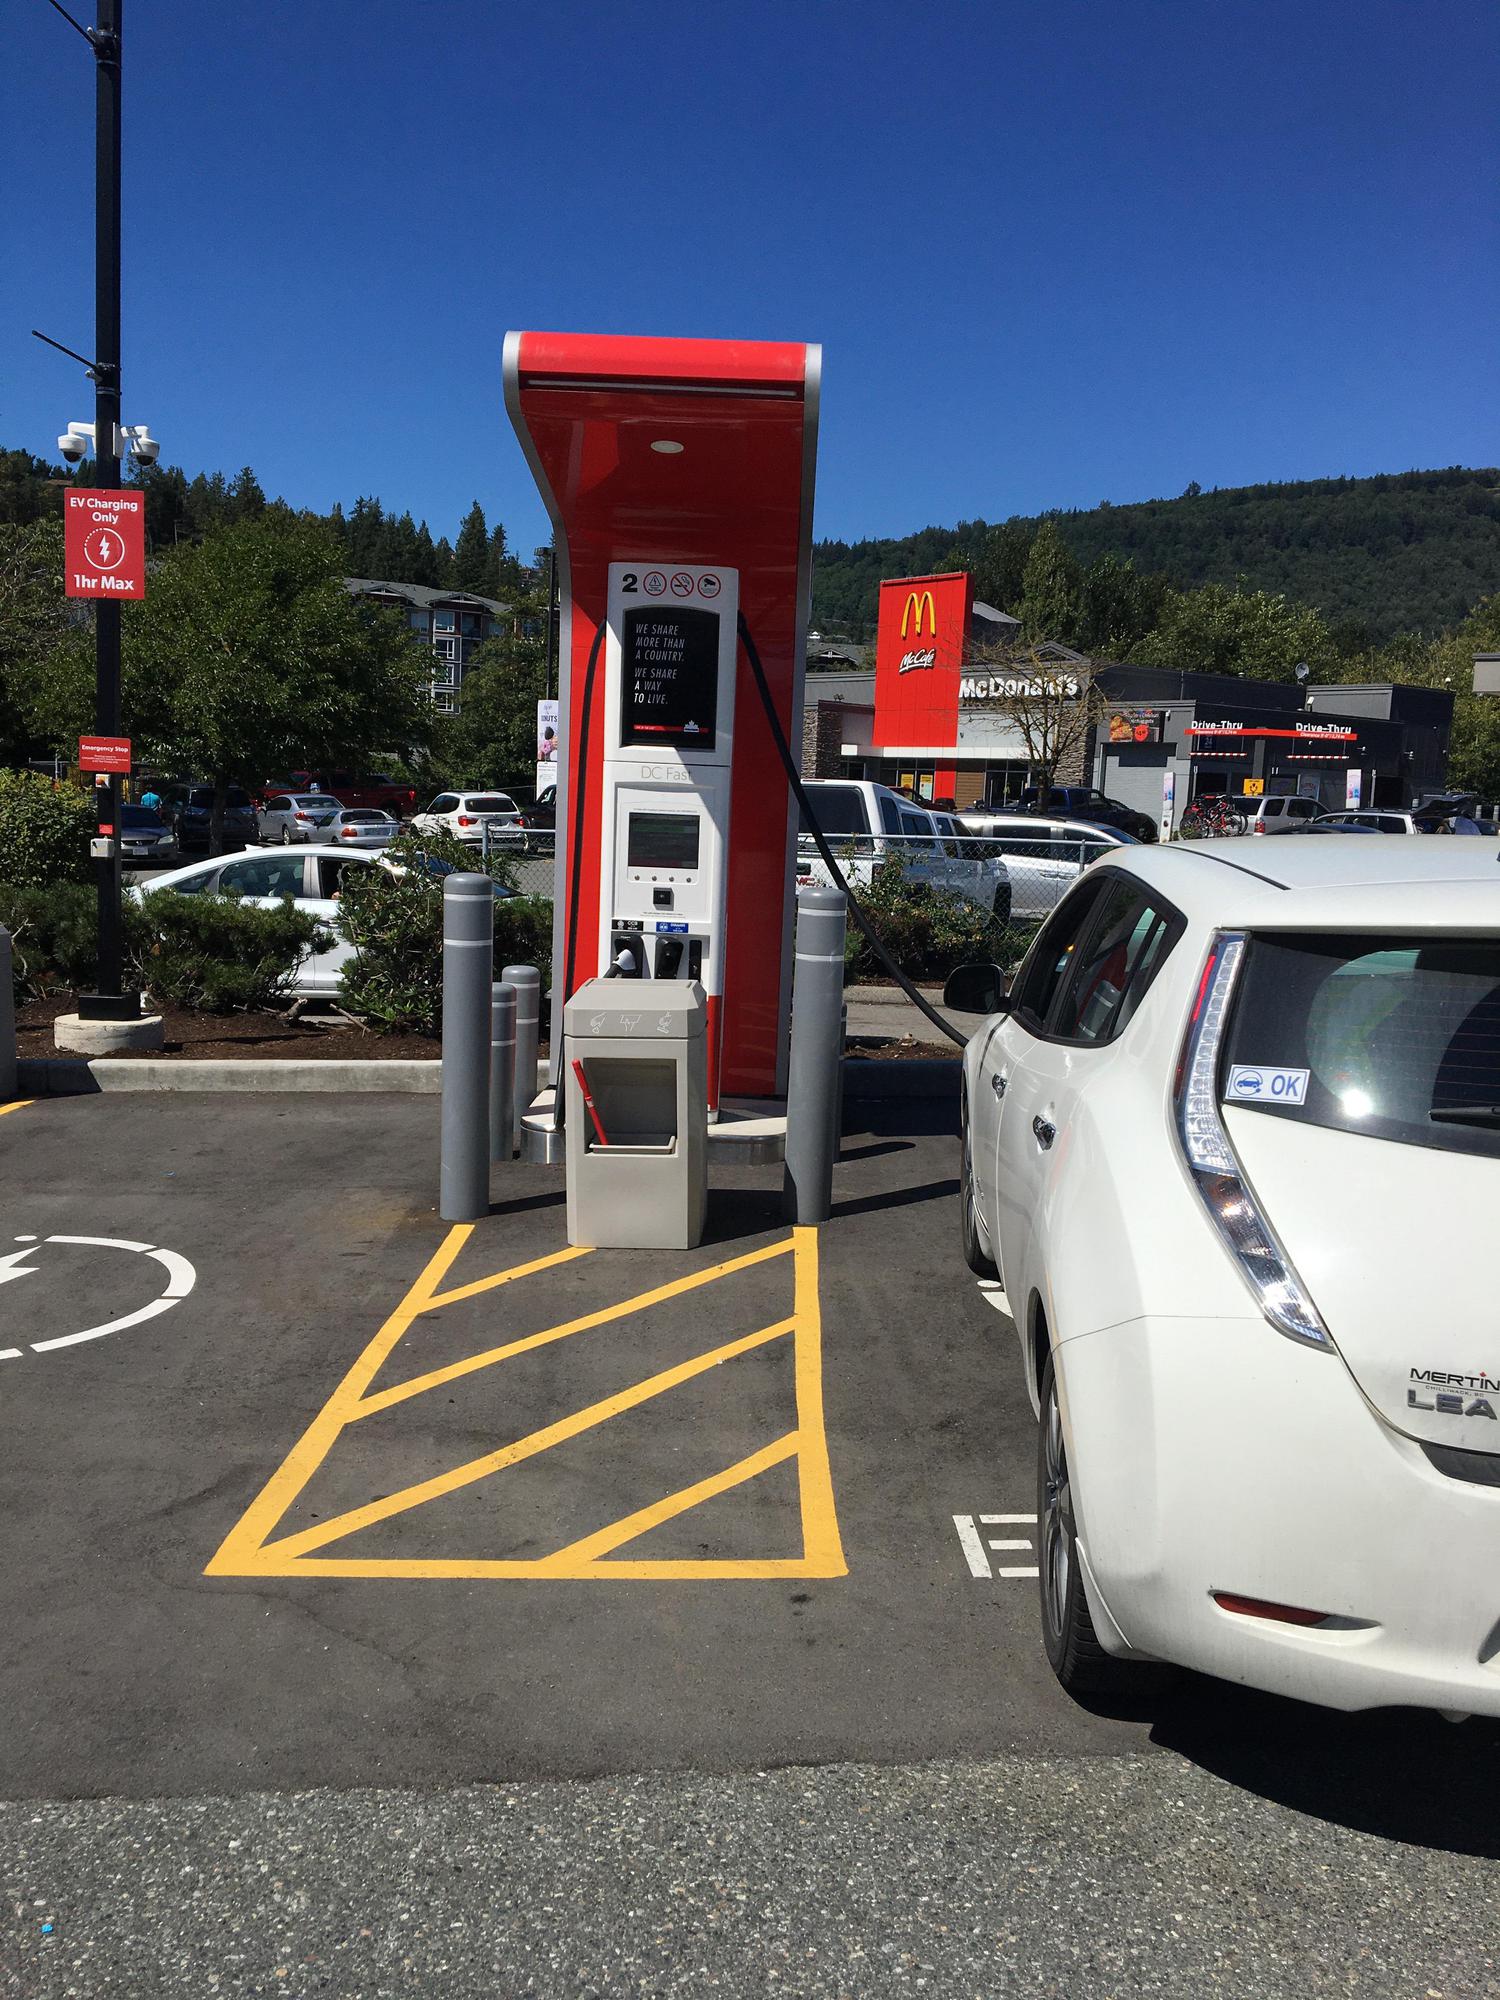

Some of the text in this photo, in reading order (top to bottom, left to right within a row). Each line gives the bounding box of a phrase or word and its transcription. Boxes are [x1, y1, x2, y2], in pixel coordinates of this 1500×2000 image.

[70, 497, 138, 512] EV Charging
[92, 512, 119, 524] Only
[74, 574, 134, 590] 1hr Max
[622, 573, 638, 592] 2
[635, 623, 679, 636] WE SHARE
[635, 637, 686, 649] MORE THAN
[635, 650, 685, 662] A COUNTRY.
[899, 649, 936, 671] McCafé
[634, 668, 678, 680] WE SHARE
[634, 680, 662, 691] A WAY
[634, 693, 669, 705] TO LIVE.
[1191, 720, 1243, 730] Drive-Thru
[1295, 722, 1352, 734] Drive-Thru
[81, 744, 114, 752] Emergency
[641, 766, 693, 781] DC Fast
[1271, 1074, 1301, 1097] OK
[1410, 1367, 1500, 1391] MERTIN
[1407, 1389, 1498, 1420] LEA
